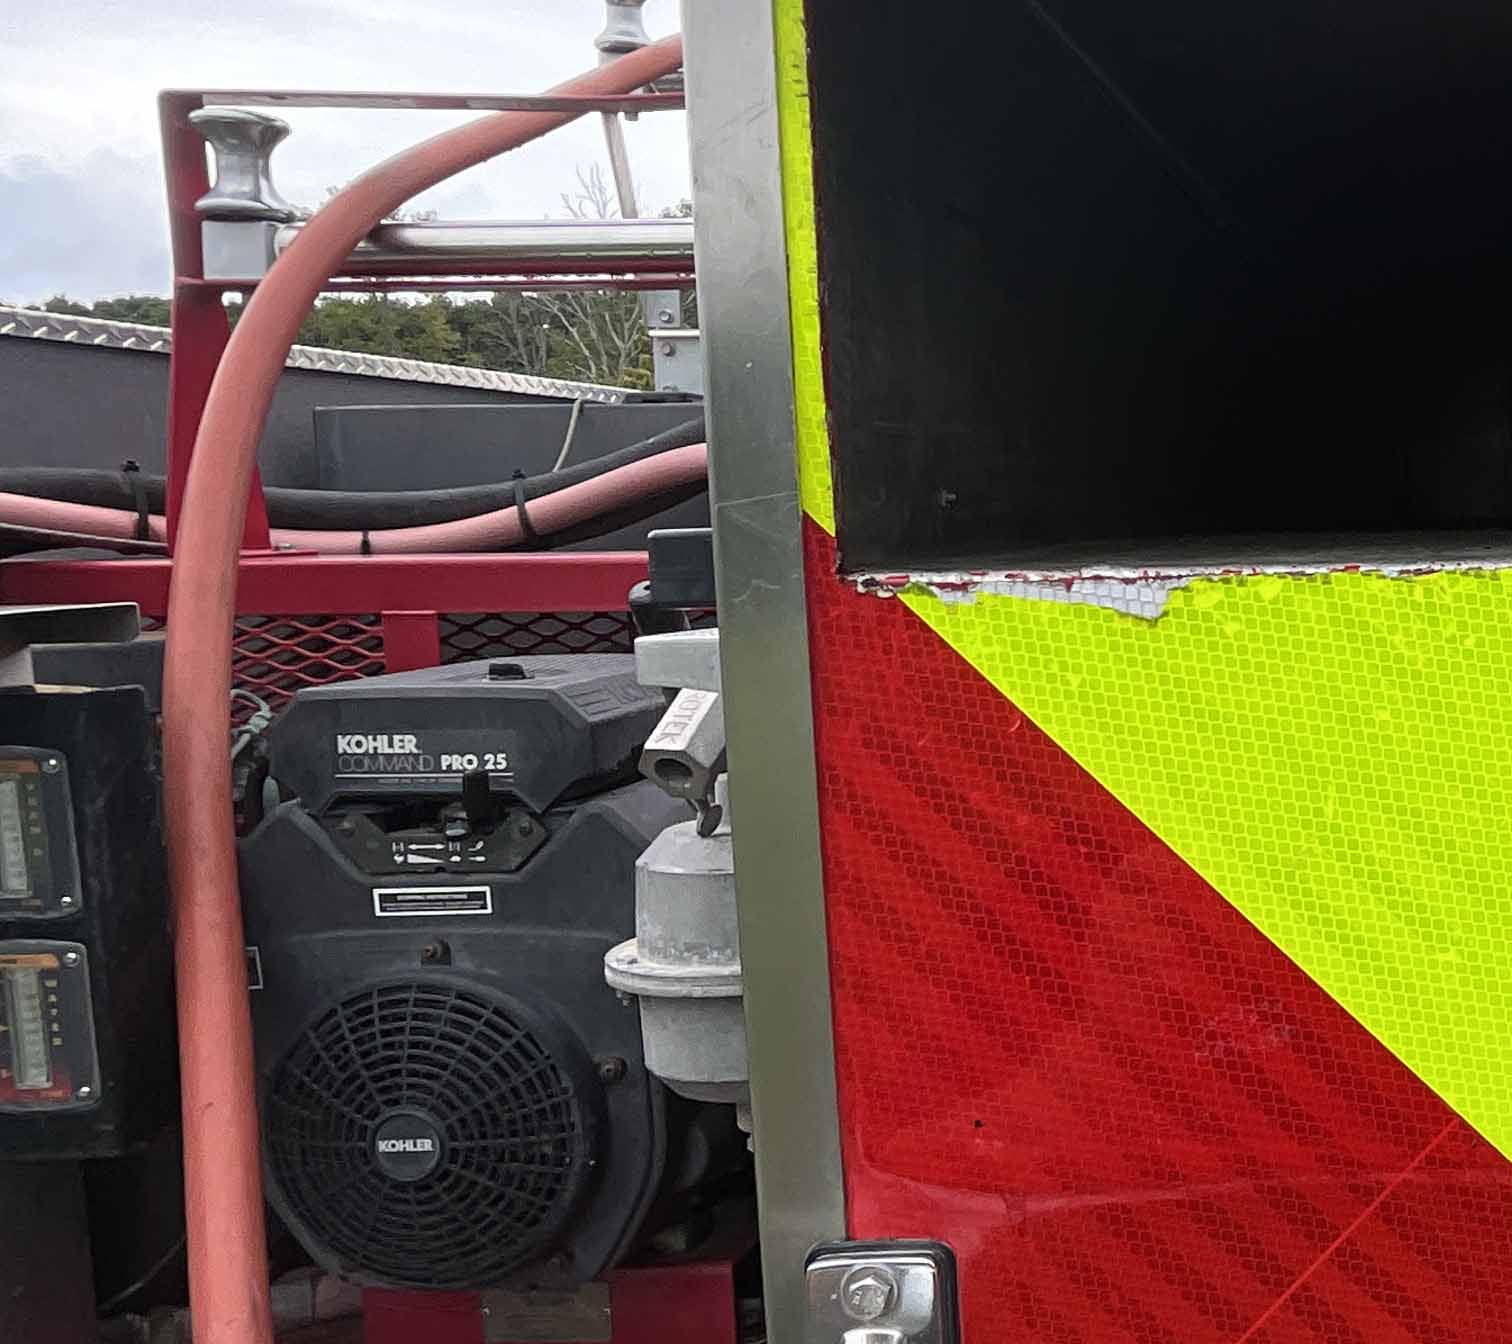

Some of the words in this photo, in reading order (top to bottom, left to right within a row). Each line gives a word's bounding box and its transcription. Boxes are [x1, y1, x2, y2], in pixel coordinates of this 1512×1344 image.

[336, 734, 418, 754] KOHLER
[338, 755, 434, 772] COMMAND
[440, 754, 479, 770] PRO
[483, 753, 508, 770] 25
[378, 1139, 433, 1152] KOHLER
